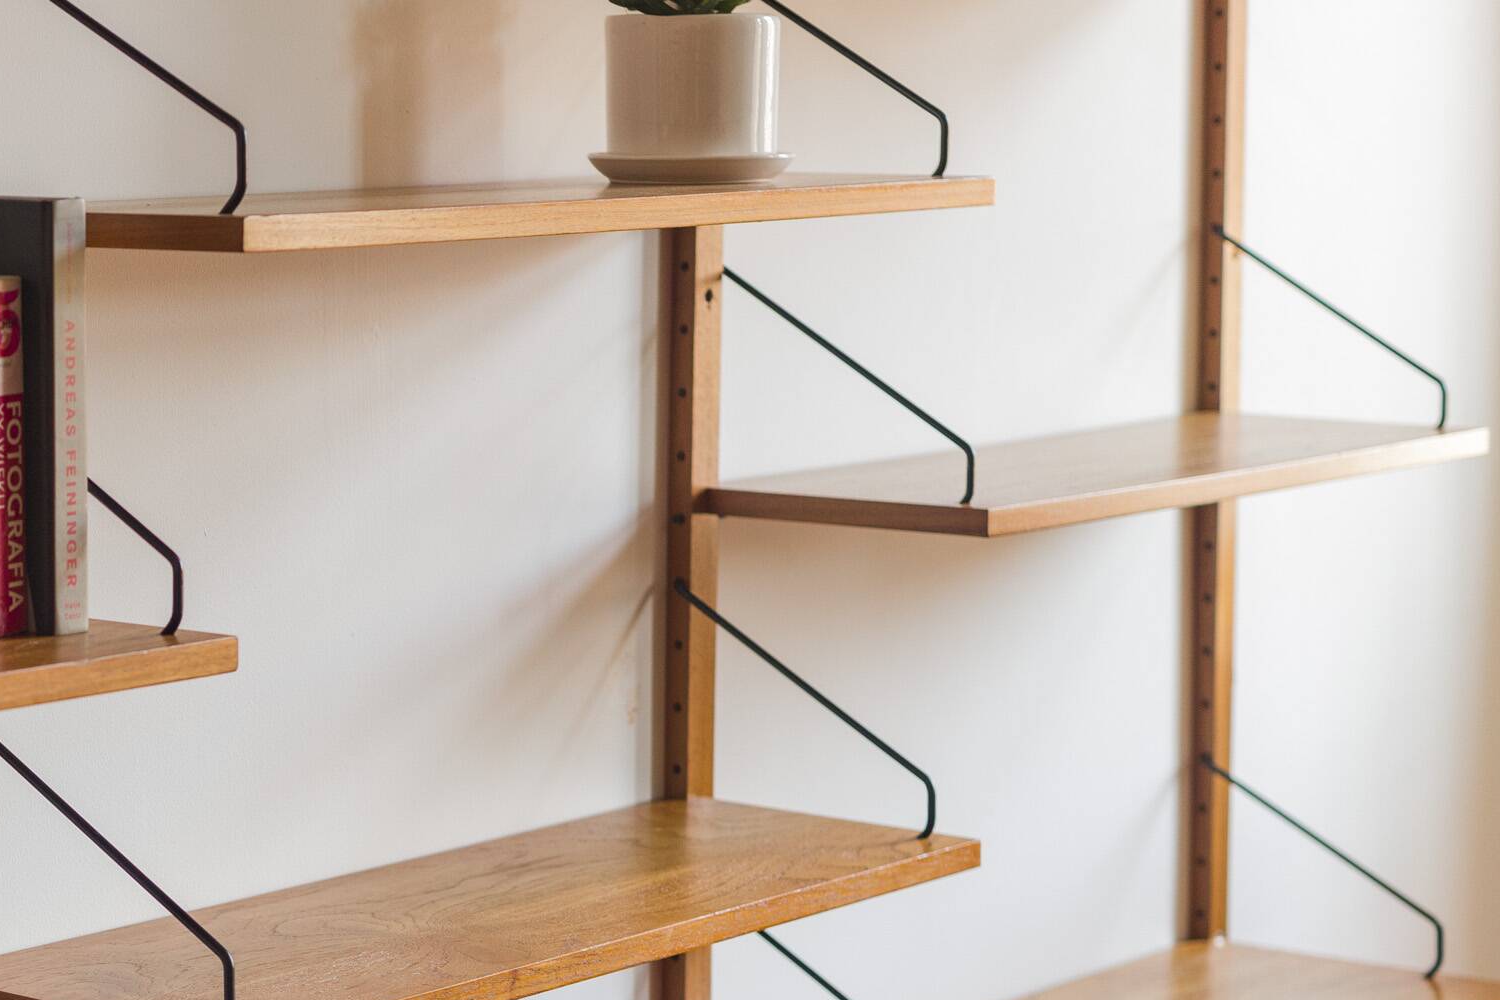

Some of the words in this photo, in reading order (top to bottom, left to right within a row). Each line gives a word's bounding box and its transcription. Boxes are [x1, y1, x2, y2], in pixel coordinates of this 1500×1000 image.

[65, 319, 76, 436] ANDREAS
[6, 401, 24, 612] FOTOGRAFIA
[66, 448, 78, 587] FEININGER
